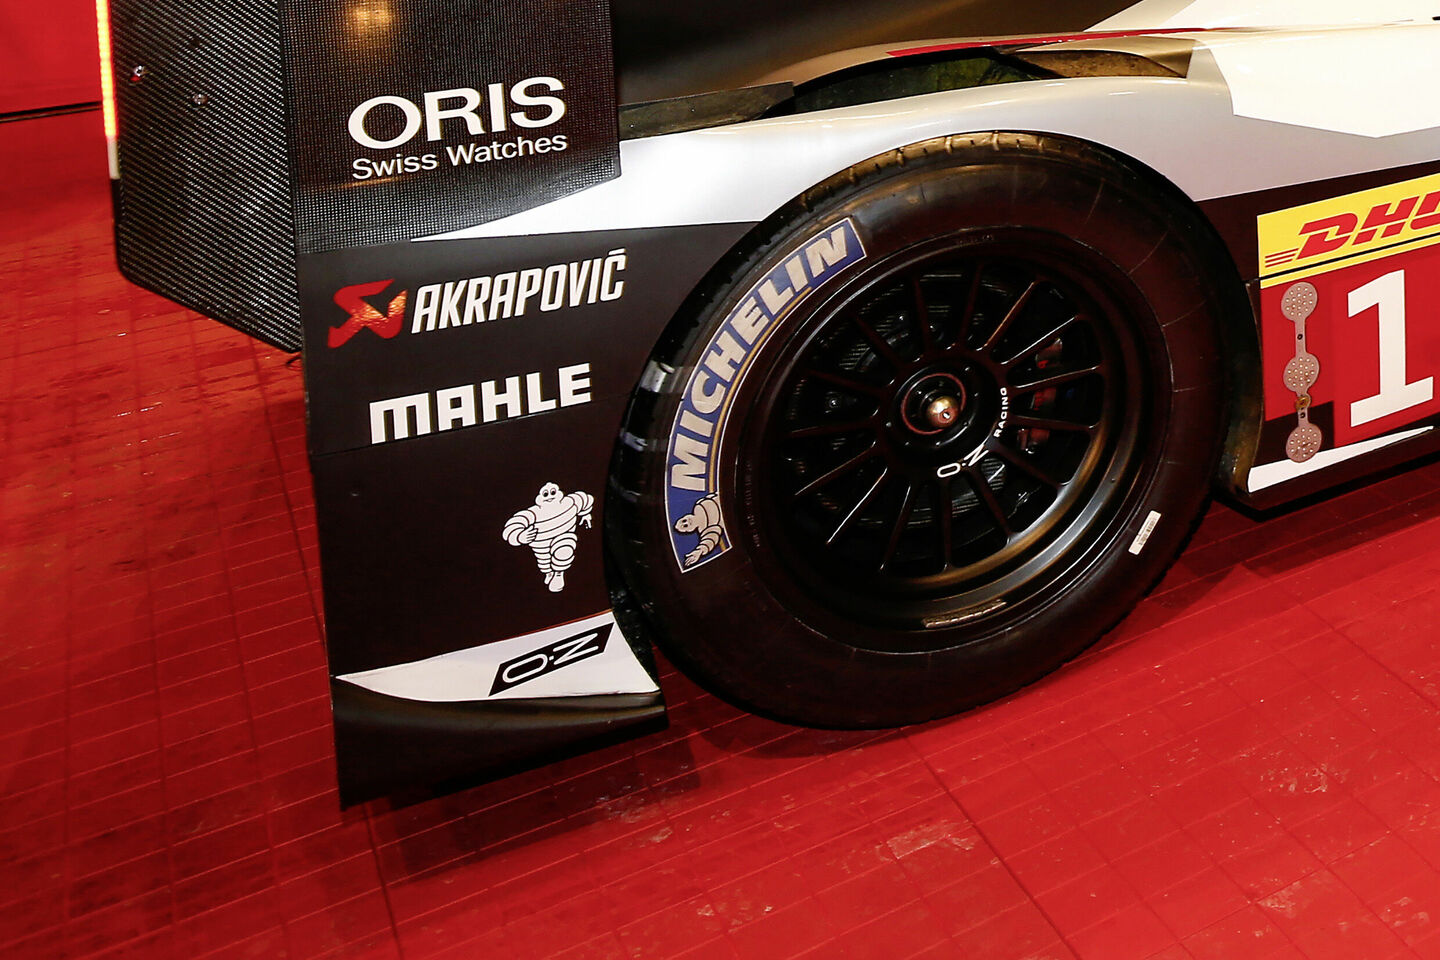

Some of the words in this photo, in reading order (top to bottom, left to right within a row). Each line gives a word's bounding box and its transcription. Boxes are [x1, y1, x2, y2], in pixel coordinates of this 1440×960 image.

[347, 77, 566, 150] ORIS
[352, 153, 438, 181] Swiss
[447, 134, 568, 167] Watches
[671, 224, 853, 492] MICHELIN
[1347, 270, 1434, 428] 1
[369, 363, 593, 444] MAHLE
[993, 387, 1009, 438] RACING
